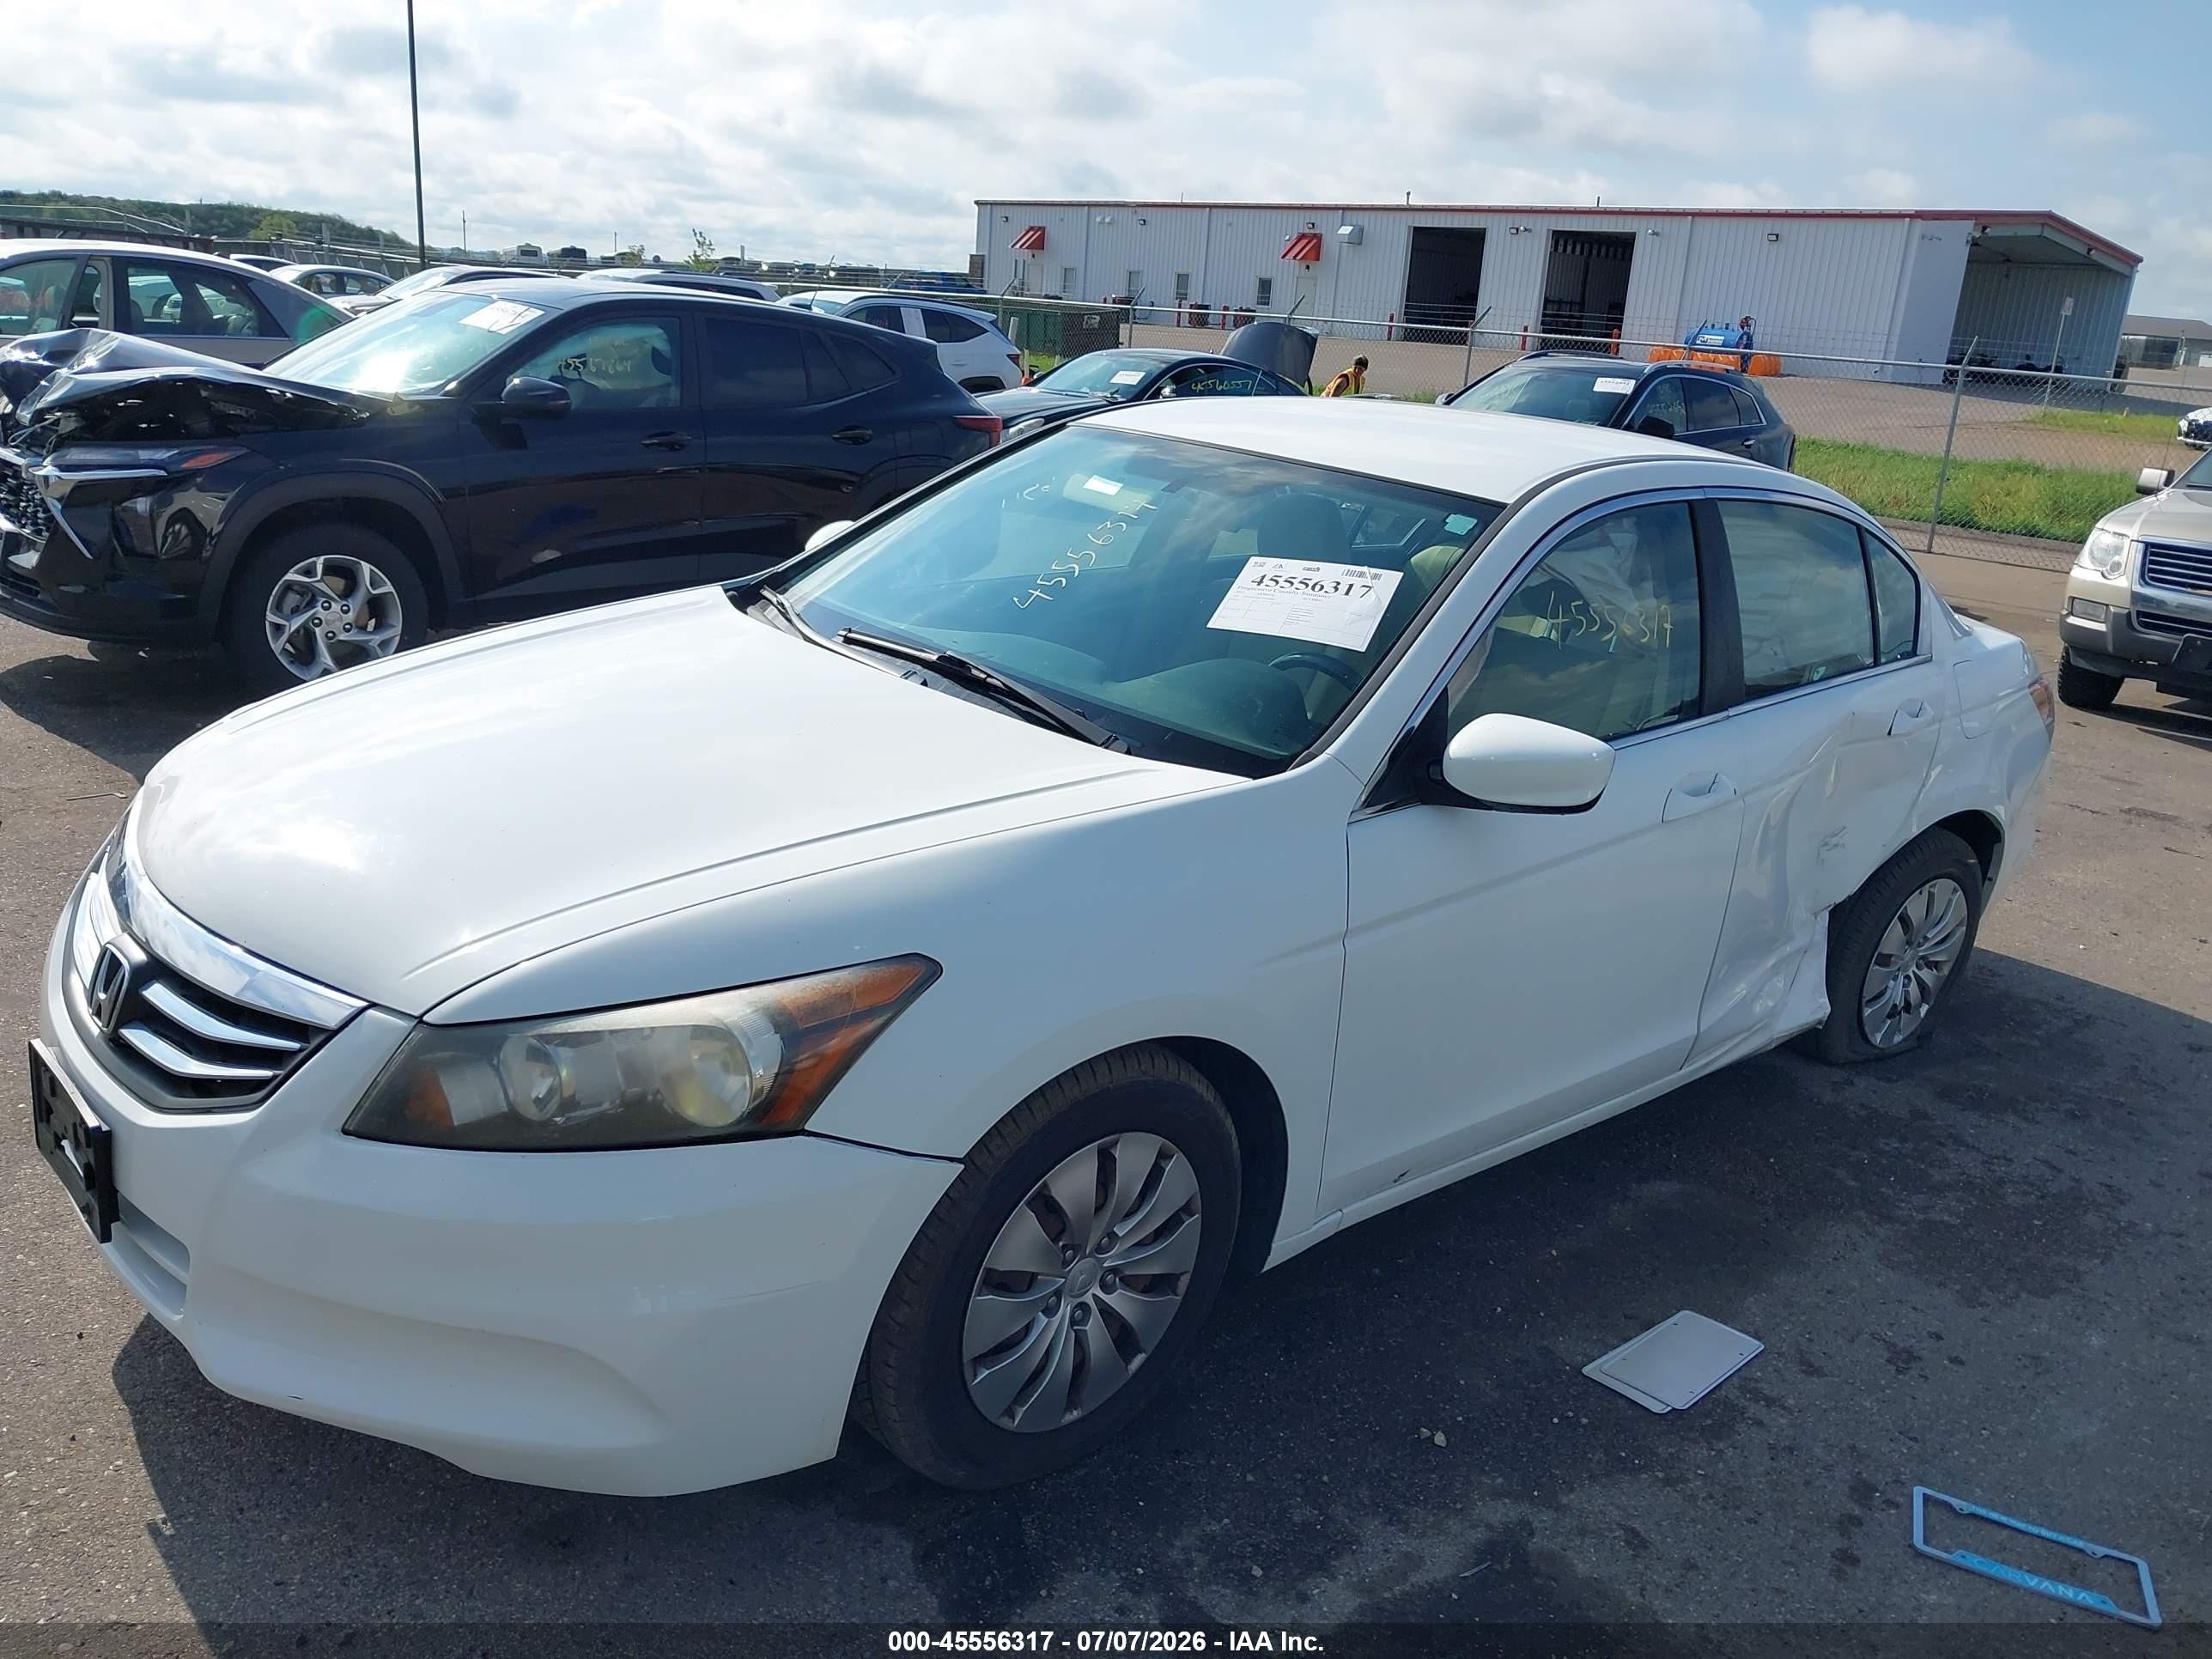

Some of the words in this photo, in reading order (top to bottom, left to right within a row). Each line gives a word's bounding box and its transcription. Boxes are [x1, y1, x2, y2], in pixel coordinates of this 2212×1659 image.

[1012, 500, 1158, 609] 45556317
[1250, 574, 1374, 599] 45556317
[1547, 591, 1674, 650] 45556317
[1975, 1559, 2094, 1604] CARVANA
